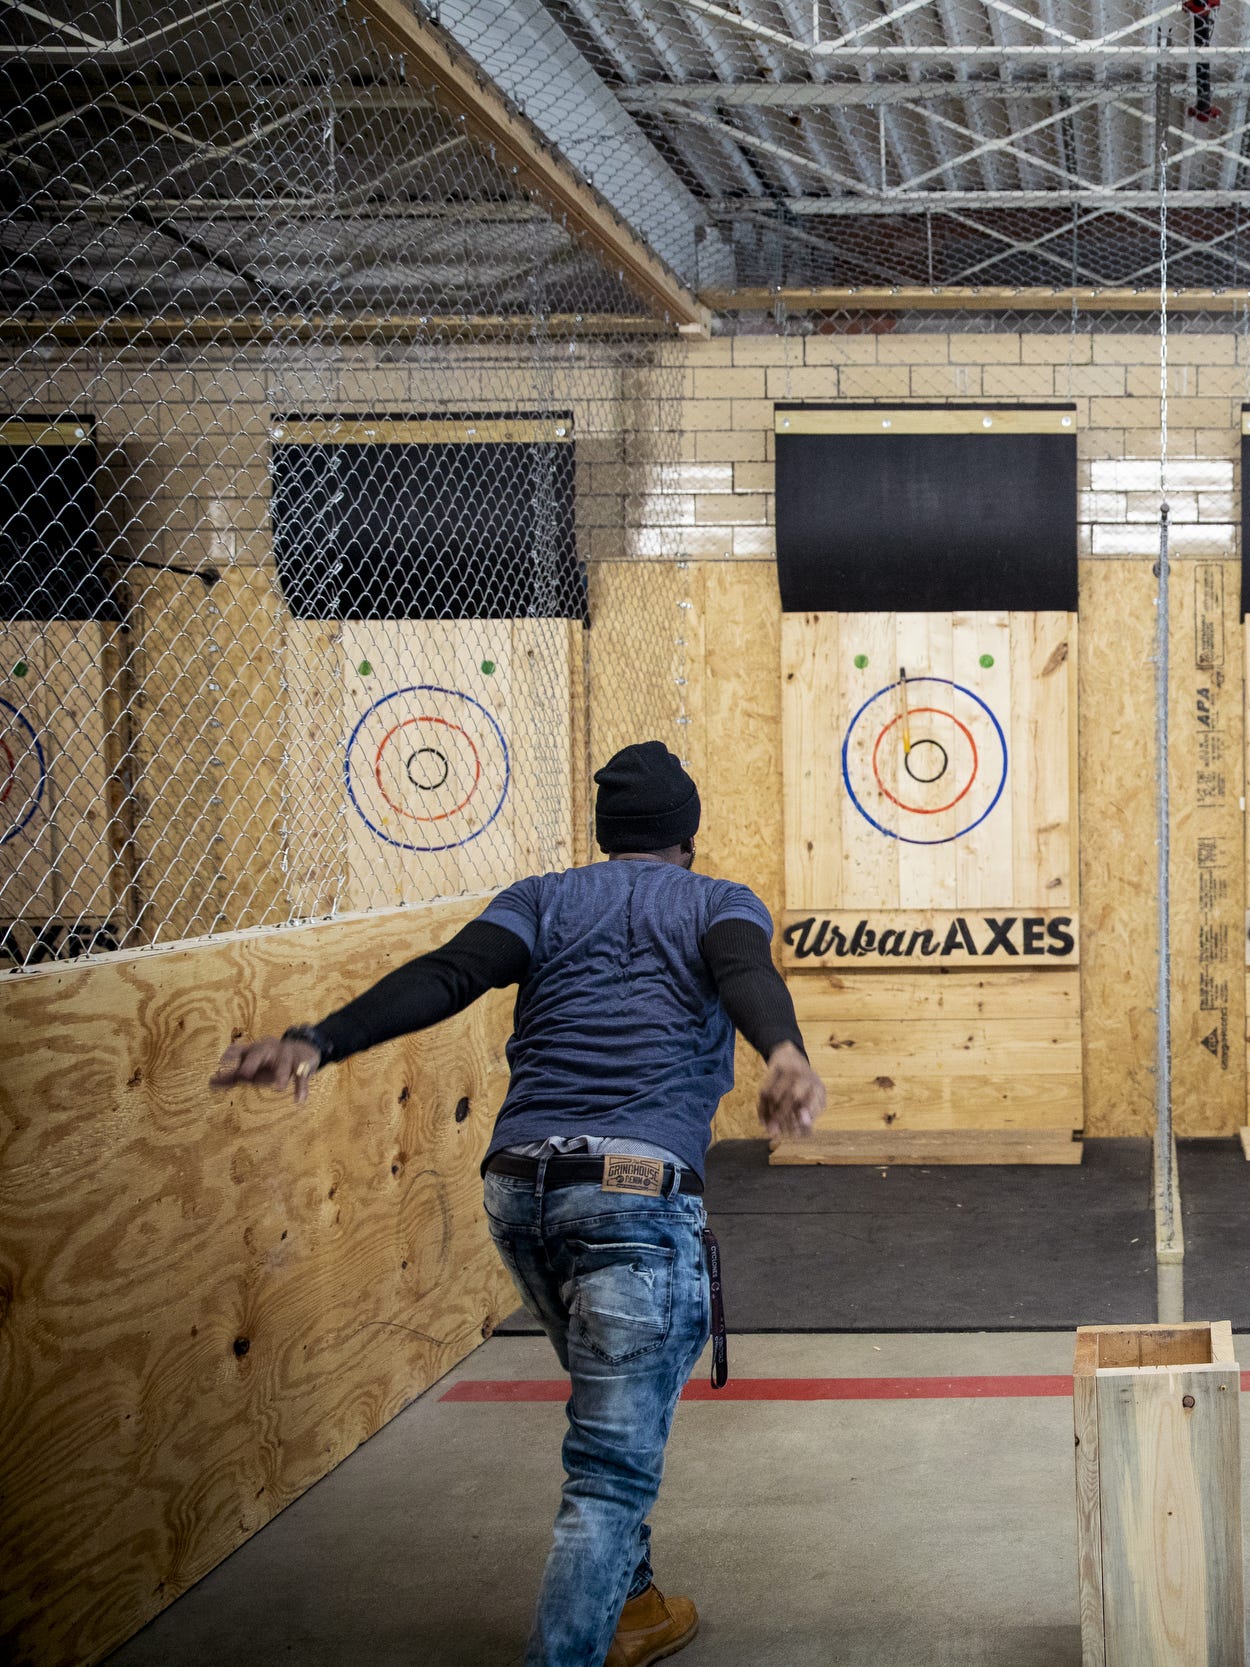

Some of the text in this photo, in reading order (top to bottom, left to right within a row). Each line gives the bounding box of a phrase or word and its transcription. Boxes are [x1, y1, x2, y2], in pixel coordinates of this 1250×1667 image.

[1196, 687, 1210, 728] APA
[782, 917, 1075, 959] Urban AXES
[608, 1163, 660, 1182] GRINDHOUSE
[710, 1245, 718, 1278] CYCLONES
